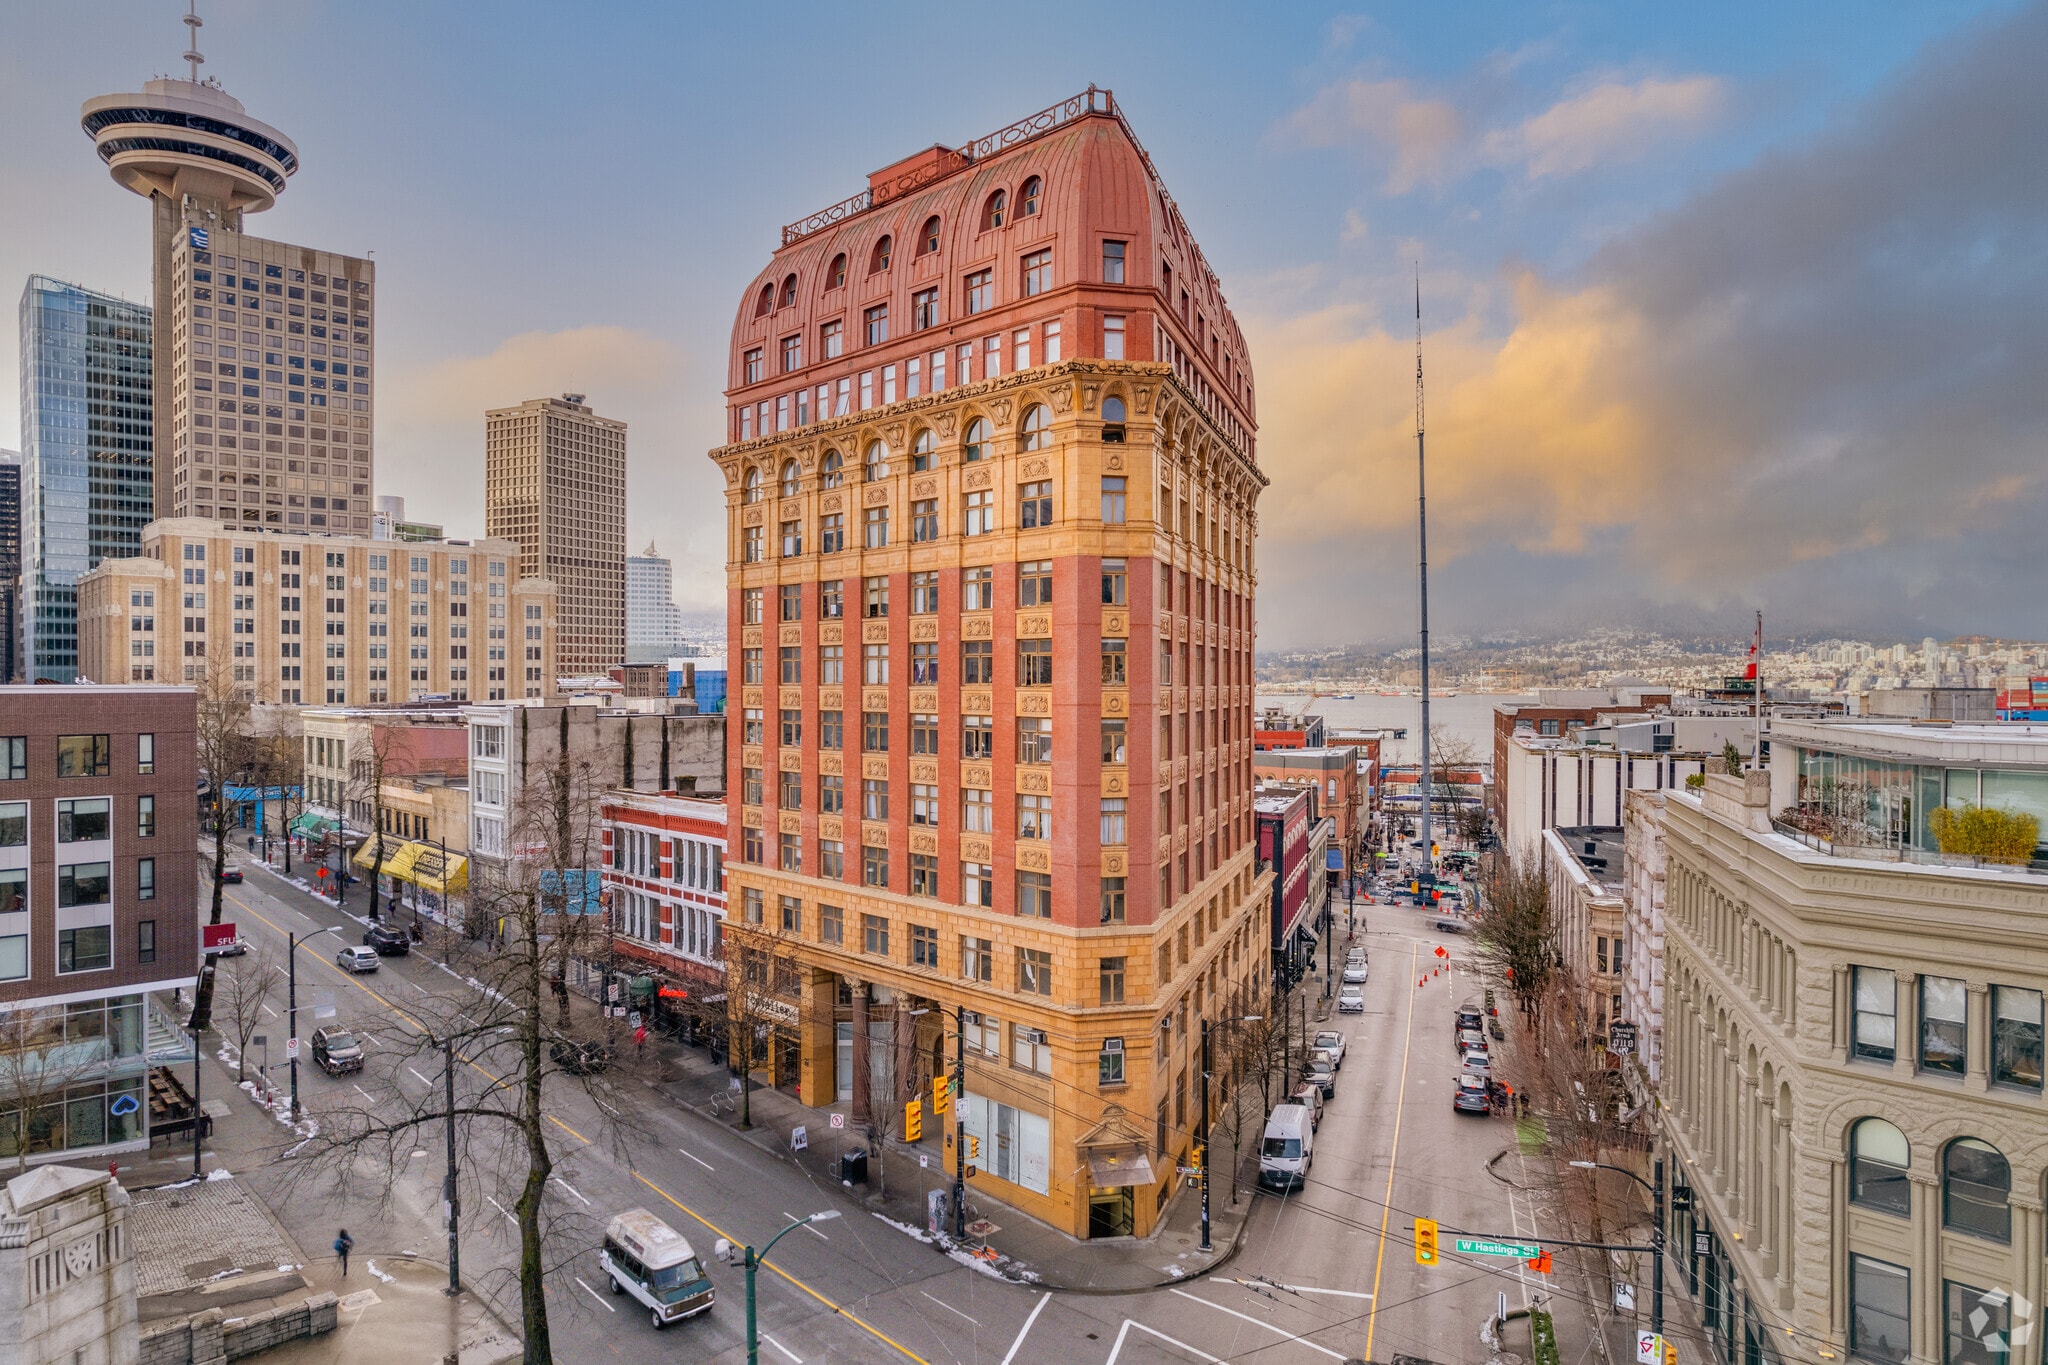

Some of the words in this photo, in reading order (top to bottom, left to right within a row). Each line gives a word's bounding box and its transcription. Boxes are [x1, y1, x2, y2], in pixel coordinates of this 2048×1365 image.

[217, 937, 236, 946] SFU
[1461, 1241, 1472, 1250] W
[1475, 1242, 1519, 1256] Hastings
[1523, 1246, 1534, 1256] St
